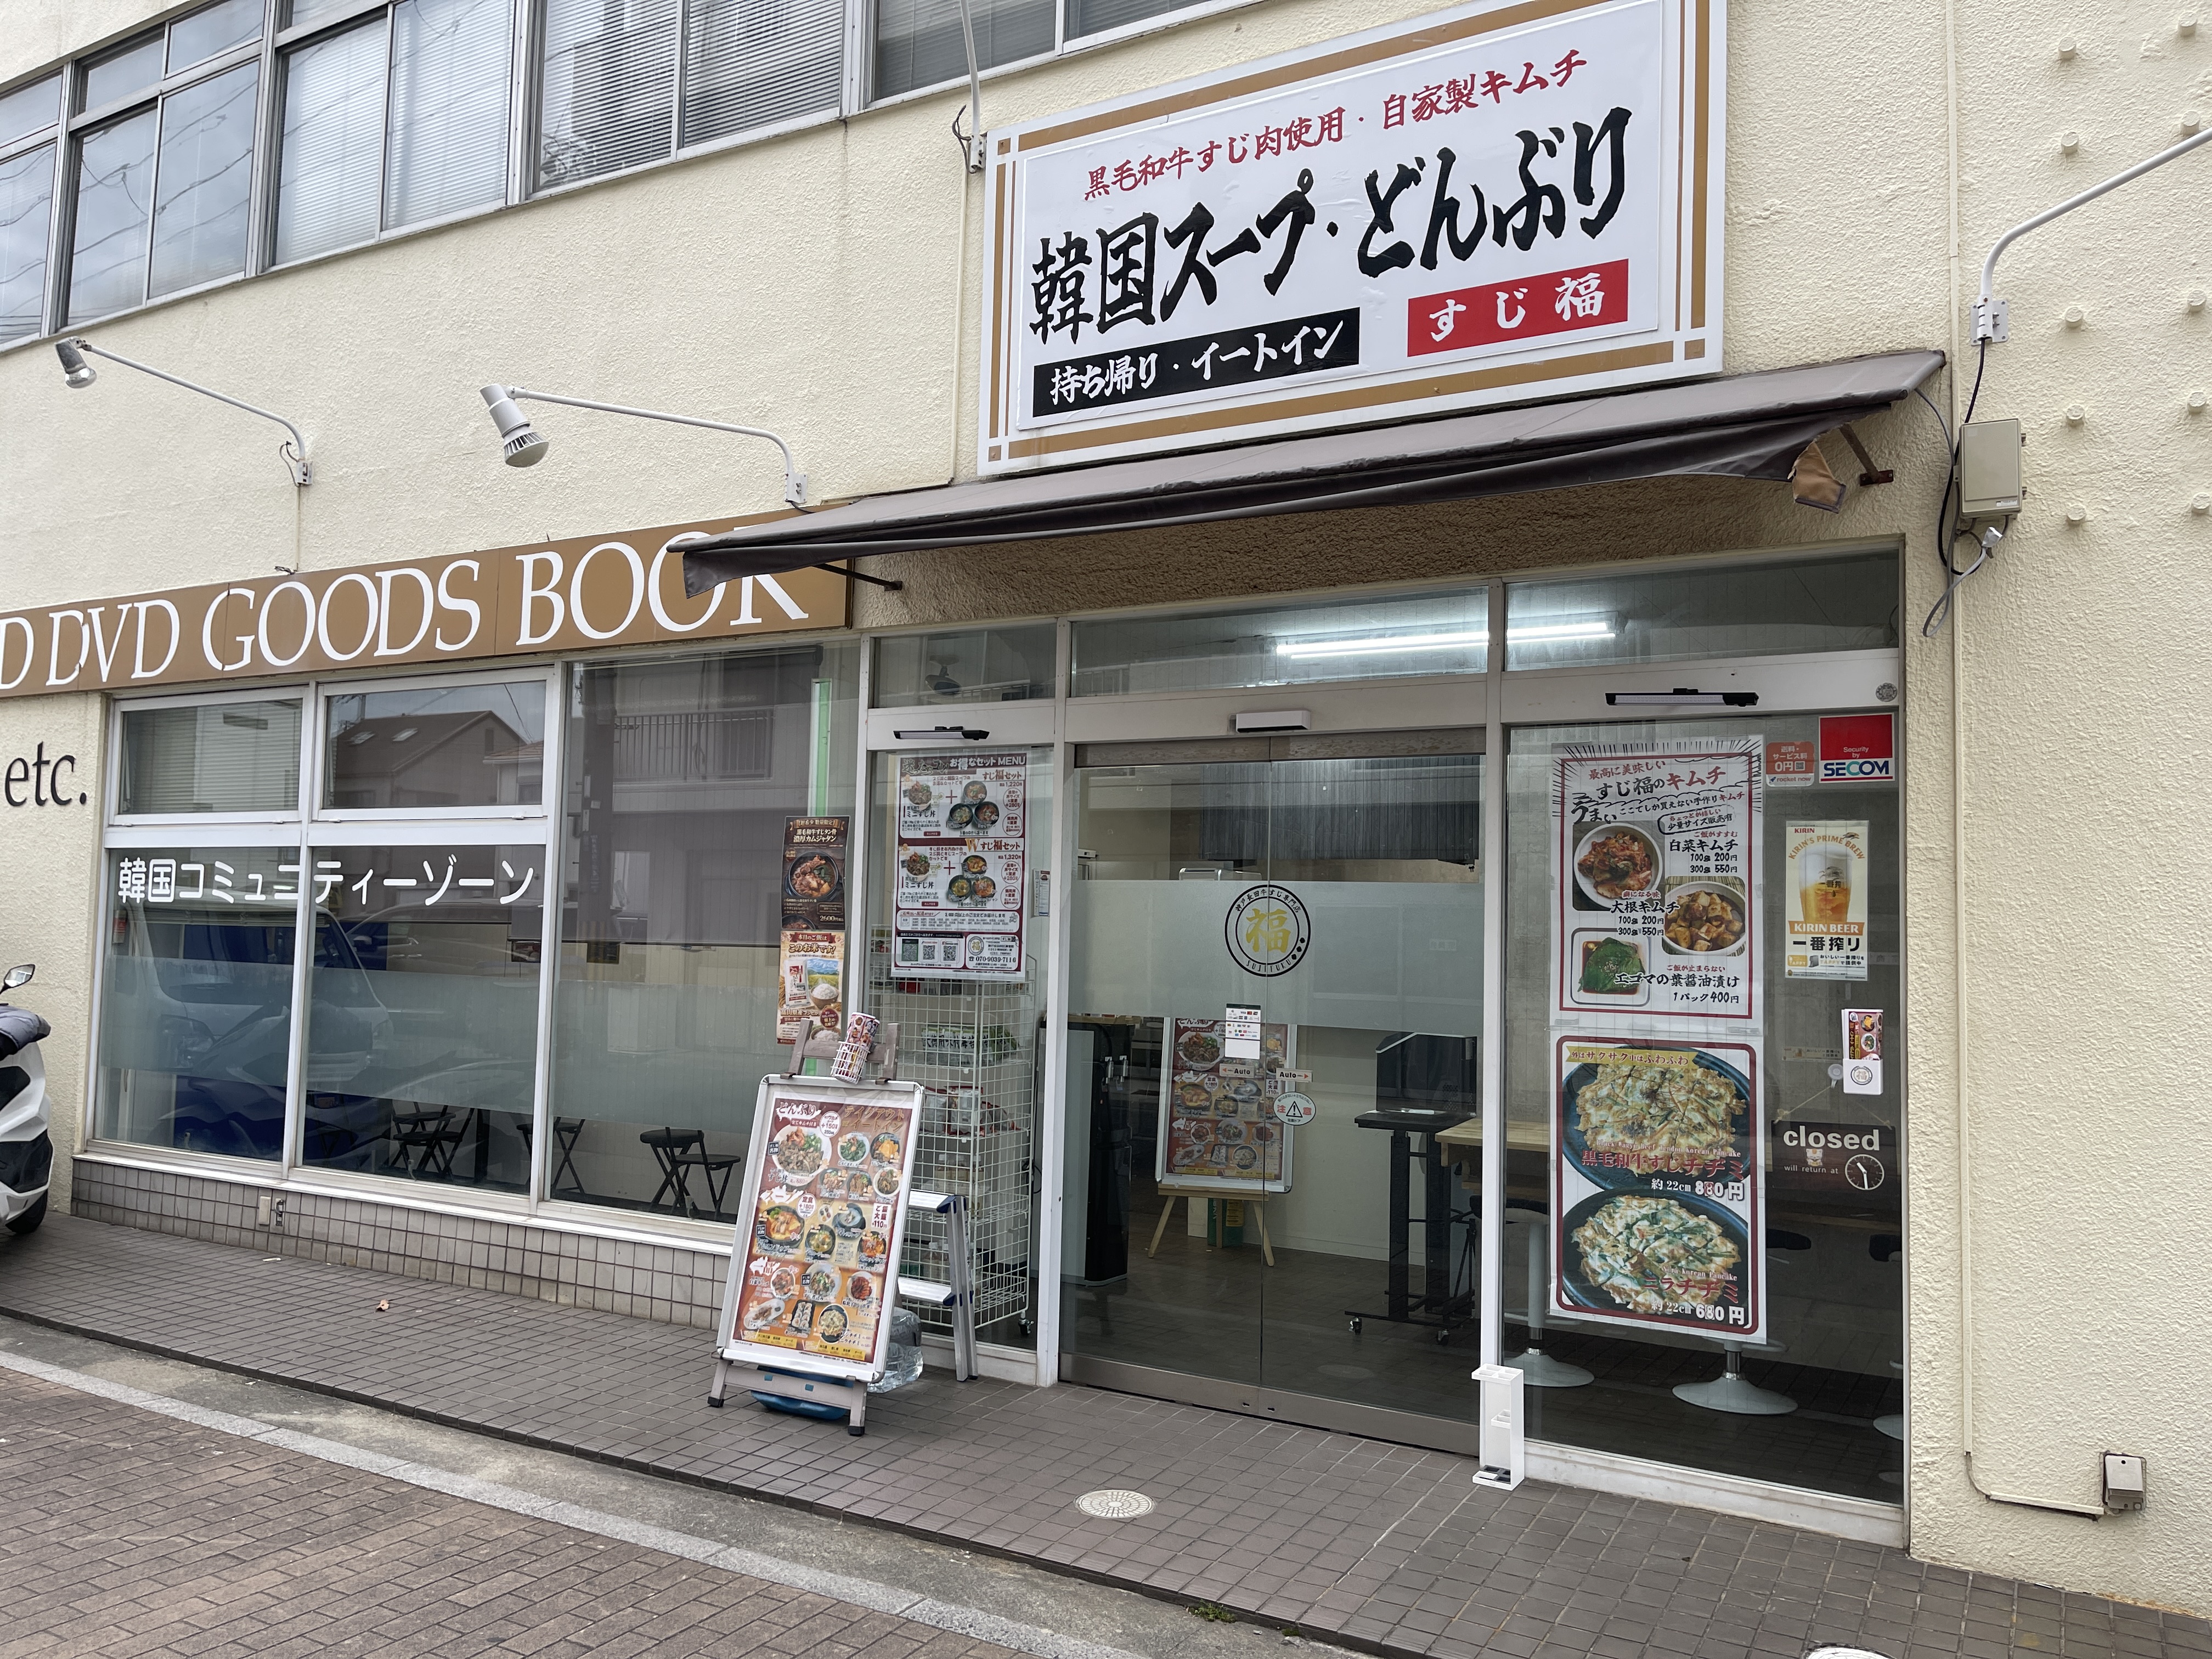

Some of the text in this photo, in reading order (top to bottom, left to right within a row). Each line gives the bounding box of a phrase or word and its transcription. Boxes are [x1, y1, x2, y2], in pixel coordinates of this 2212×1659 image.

[1030, 106, 1633, 345] 韓国スープ・どんぶり
[1430, 272, 1605, 343] すじ福
[46, 599, 180, 686] DVD
[202, 558, 481, 672] GOODS
[950, 756, 1026, 770] お得なセット MENU
[1588, 760, 1666, 780] 最高に美味しい
[1774, 761, 1793, 772] 0円
[1824, 760, 1889, 777] SECOM
[4, 741, 87, 807] etc.
[982, 770, 1022, 781] すじ福セット
[1596, 766, 1726, 799] すじ福のキムチ
[1669, 839, 1739, 851] 白菜キムチ
[1788, 835, 1866, 860] KIRIN'S PRIME BREW
[1714, 853, 1737, 862] 200円
[1714, 864, 1737, 873] 550円
[118, 854, 534, 905] 韓国コミュニティーゾーン
[1610, 900, 1680, 914] 大根キムチ
[1641, 916, 1664, 925] 200円
[1246, 908, 1291, 953] 福
[1641, 927, 1664, 936] 550円
[1794, 923, 1859, 933] KIRIN BEER
[788, 943, 837, 955] このお米です!
[1792, 936, 1860, 951] 一番搾り
[1666, 964, 1726, 973] ご飯が止まらない
[1614, 973, 1740, 989] エゴマの葉醤油漬け
[1571, 1049, 1689, 1066] 外はサクサク中はふわふわ
[778, 1102, 817, 1116] どんぶり
[844, 1105, 905, 1122] テイクアウト
[1277, 1104, 1286, 1114] 注
[850, 1119, 903, 1132] イートイン
[1783, 1125, 1880, 1151] closed
[1685, 1147, 1710, 1155] Korean
[1713, 1148, 1741, 1158] Pancake
[1581, 1149, 1744, 1180] 黒毛和牛すじチヂミ
[1802, 1166, 1826, 1174] return
[1651, 1178, 1663, 1190] 約
[1682, 1268, 1706, 1277] Korean
[1709, 1271, 1737, 1281] Pancake
[1643, 1276, 1739, 1304] ニラチヂミ
